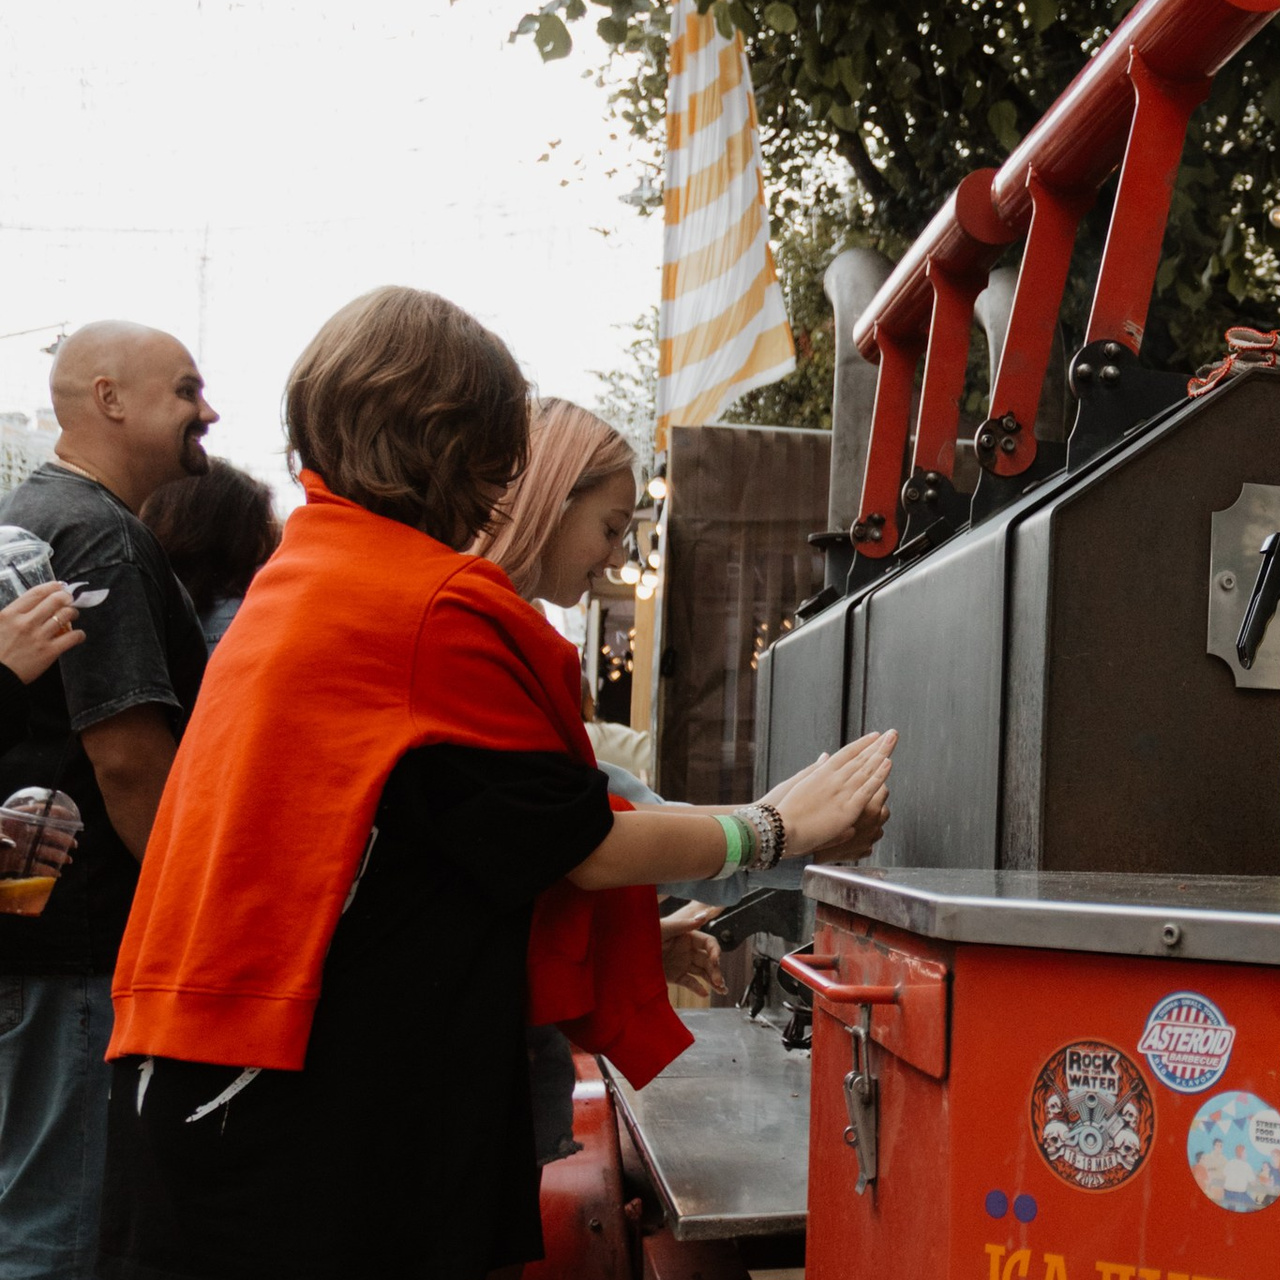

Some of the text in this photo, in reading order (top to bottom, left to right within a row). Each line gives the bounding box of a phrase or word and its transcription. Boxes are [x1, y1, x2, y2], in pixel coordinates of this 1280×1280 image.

[1142, 1024, 1232, 1055] ASTEROID
[1068, 1050, 1116, 1075] ROCK
[1169, 1053, 1220, 1067] BARBECUE
[1068, 1074, 1116, 1091] WATER
[1175, 1071, 1213, 1087] FLAVOR
[1255, 1135, 1280, 1145] RUSSIA
[1256, 1128, 1274, 1136] FOOD
